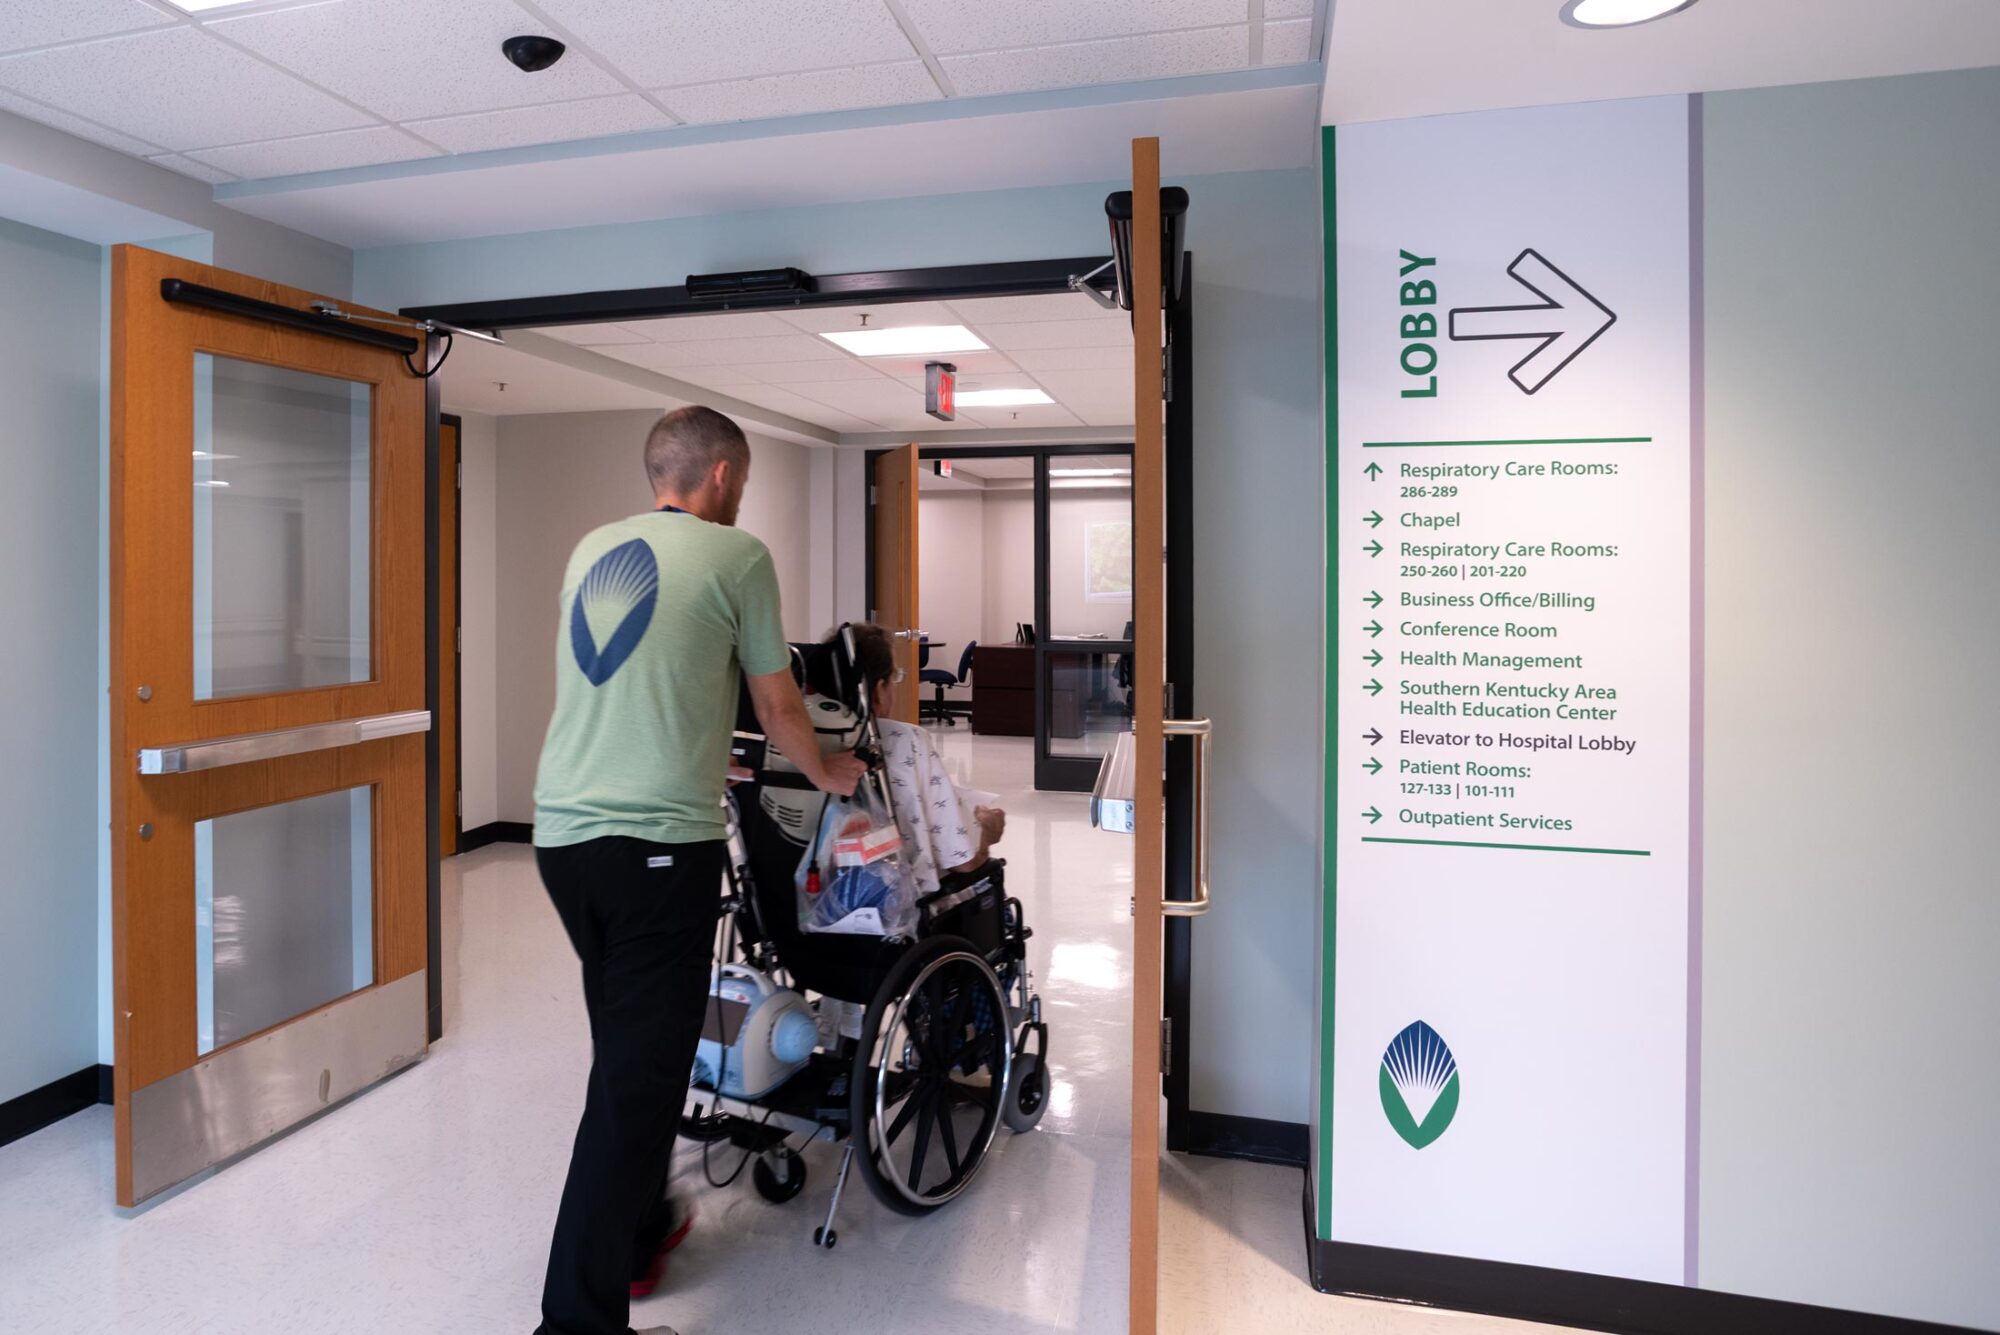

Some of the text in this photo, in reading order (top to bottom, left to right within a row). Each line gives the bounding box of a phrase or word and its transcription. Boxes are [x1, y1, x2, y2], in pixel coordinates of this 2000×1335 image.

[1399, 248, 1437, 399] LOBBY
[1400, 461, 1619, 480] Respiratory Care Rooms:
[1399, 486, 1458, 497] 286-289
[1400, 512, 1460, 530] Chapel
[1400, 542, 1619, 560] Respiratory Care Rooms:
[1400, 566, 1458, 577] 250-260
[1469, 566, 1527, 577] 201-220
[1400, 592, 1596, 611] Business Office/Billing
[1399, 621, 1558, 637] Conference Room
[1400, 651, 1583, 671] Health Management
[1400, 680, 1617, 702] Southern Kentucky Area
[1400, 700, 1618, 720] Health Education Center
[1399, 729, 1637, 755] Elevator to Hospital Lobby
[1399, 759, 1531, 778] Patient Rooms:
[1399, 783, 1452, 795] 127-133
[1464, 785, 1515, 798] 101-111
[1398, 809, 1573, 830] Outpatient Services
